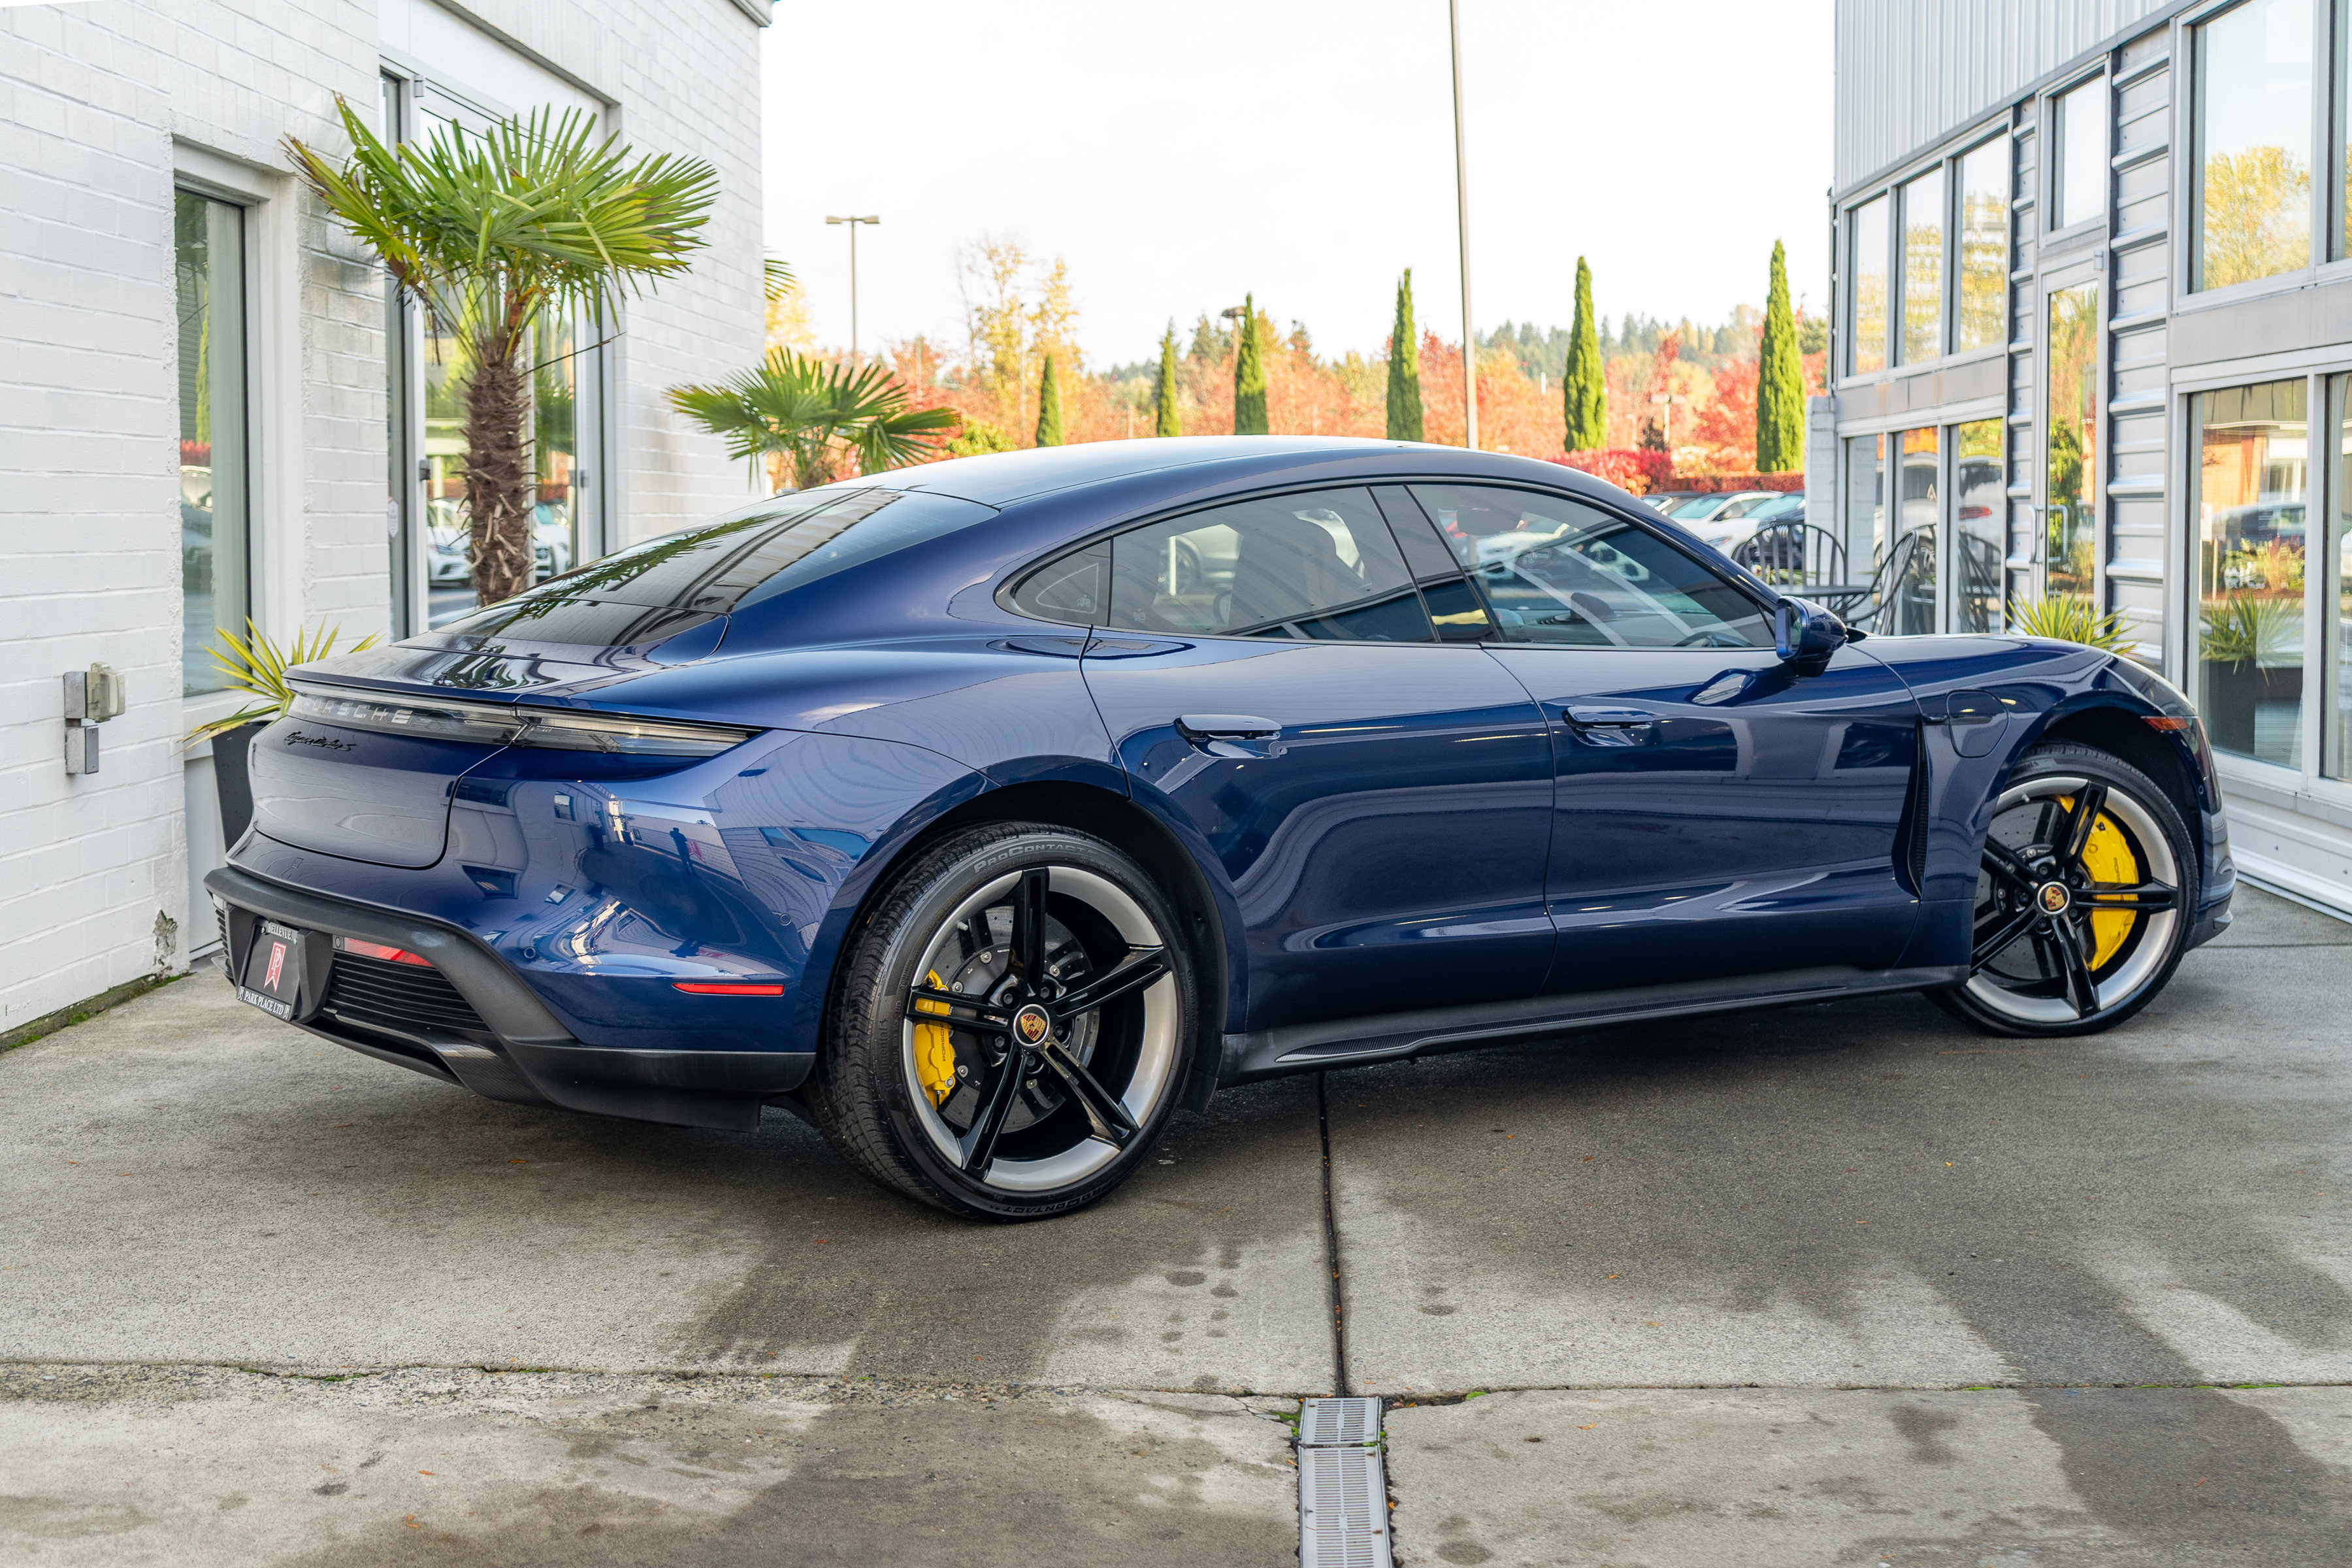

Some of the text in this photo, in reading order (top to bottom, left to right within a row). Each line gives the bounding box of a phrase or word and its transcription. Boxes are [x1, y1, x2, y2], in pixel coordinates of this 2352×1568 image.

[267, 923, 292, 939] BELLEVUE
[244, 990, 259, 1005] PARK
[257, 996, 274, 1011] PLACE
[272, 1002, 284, 1015] LTD
